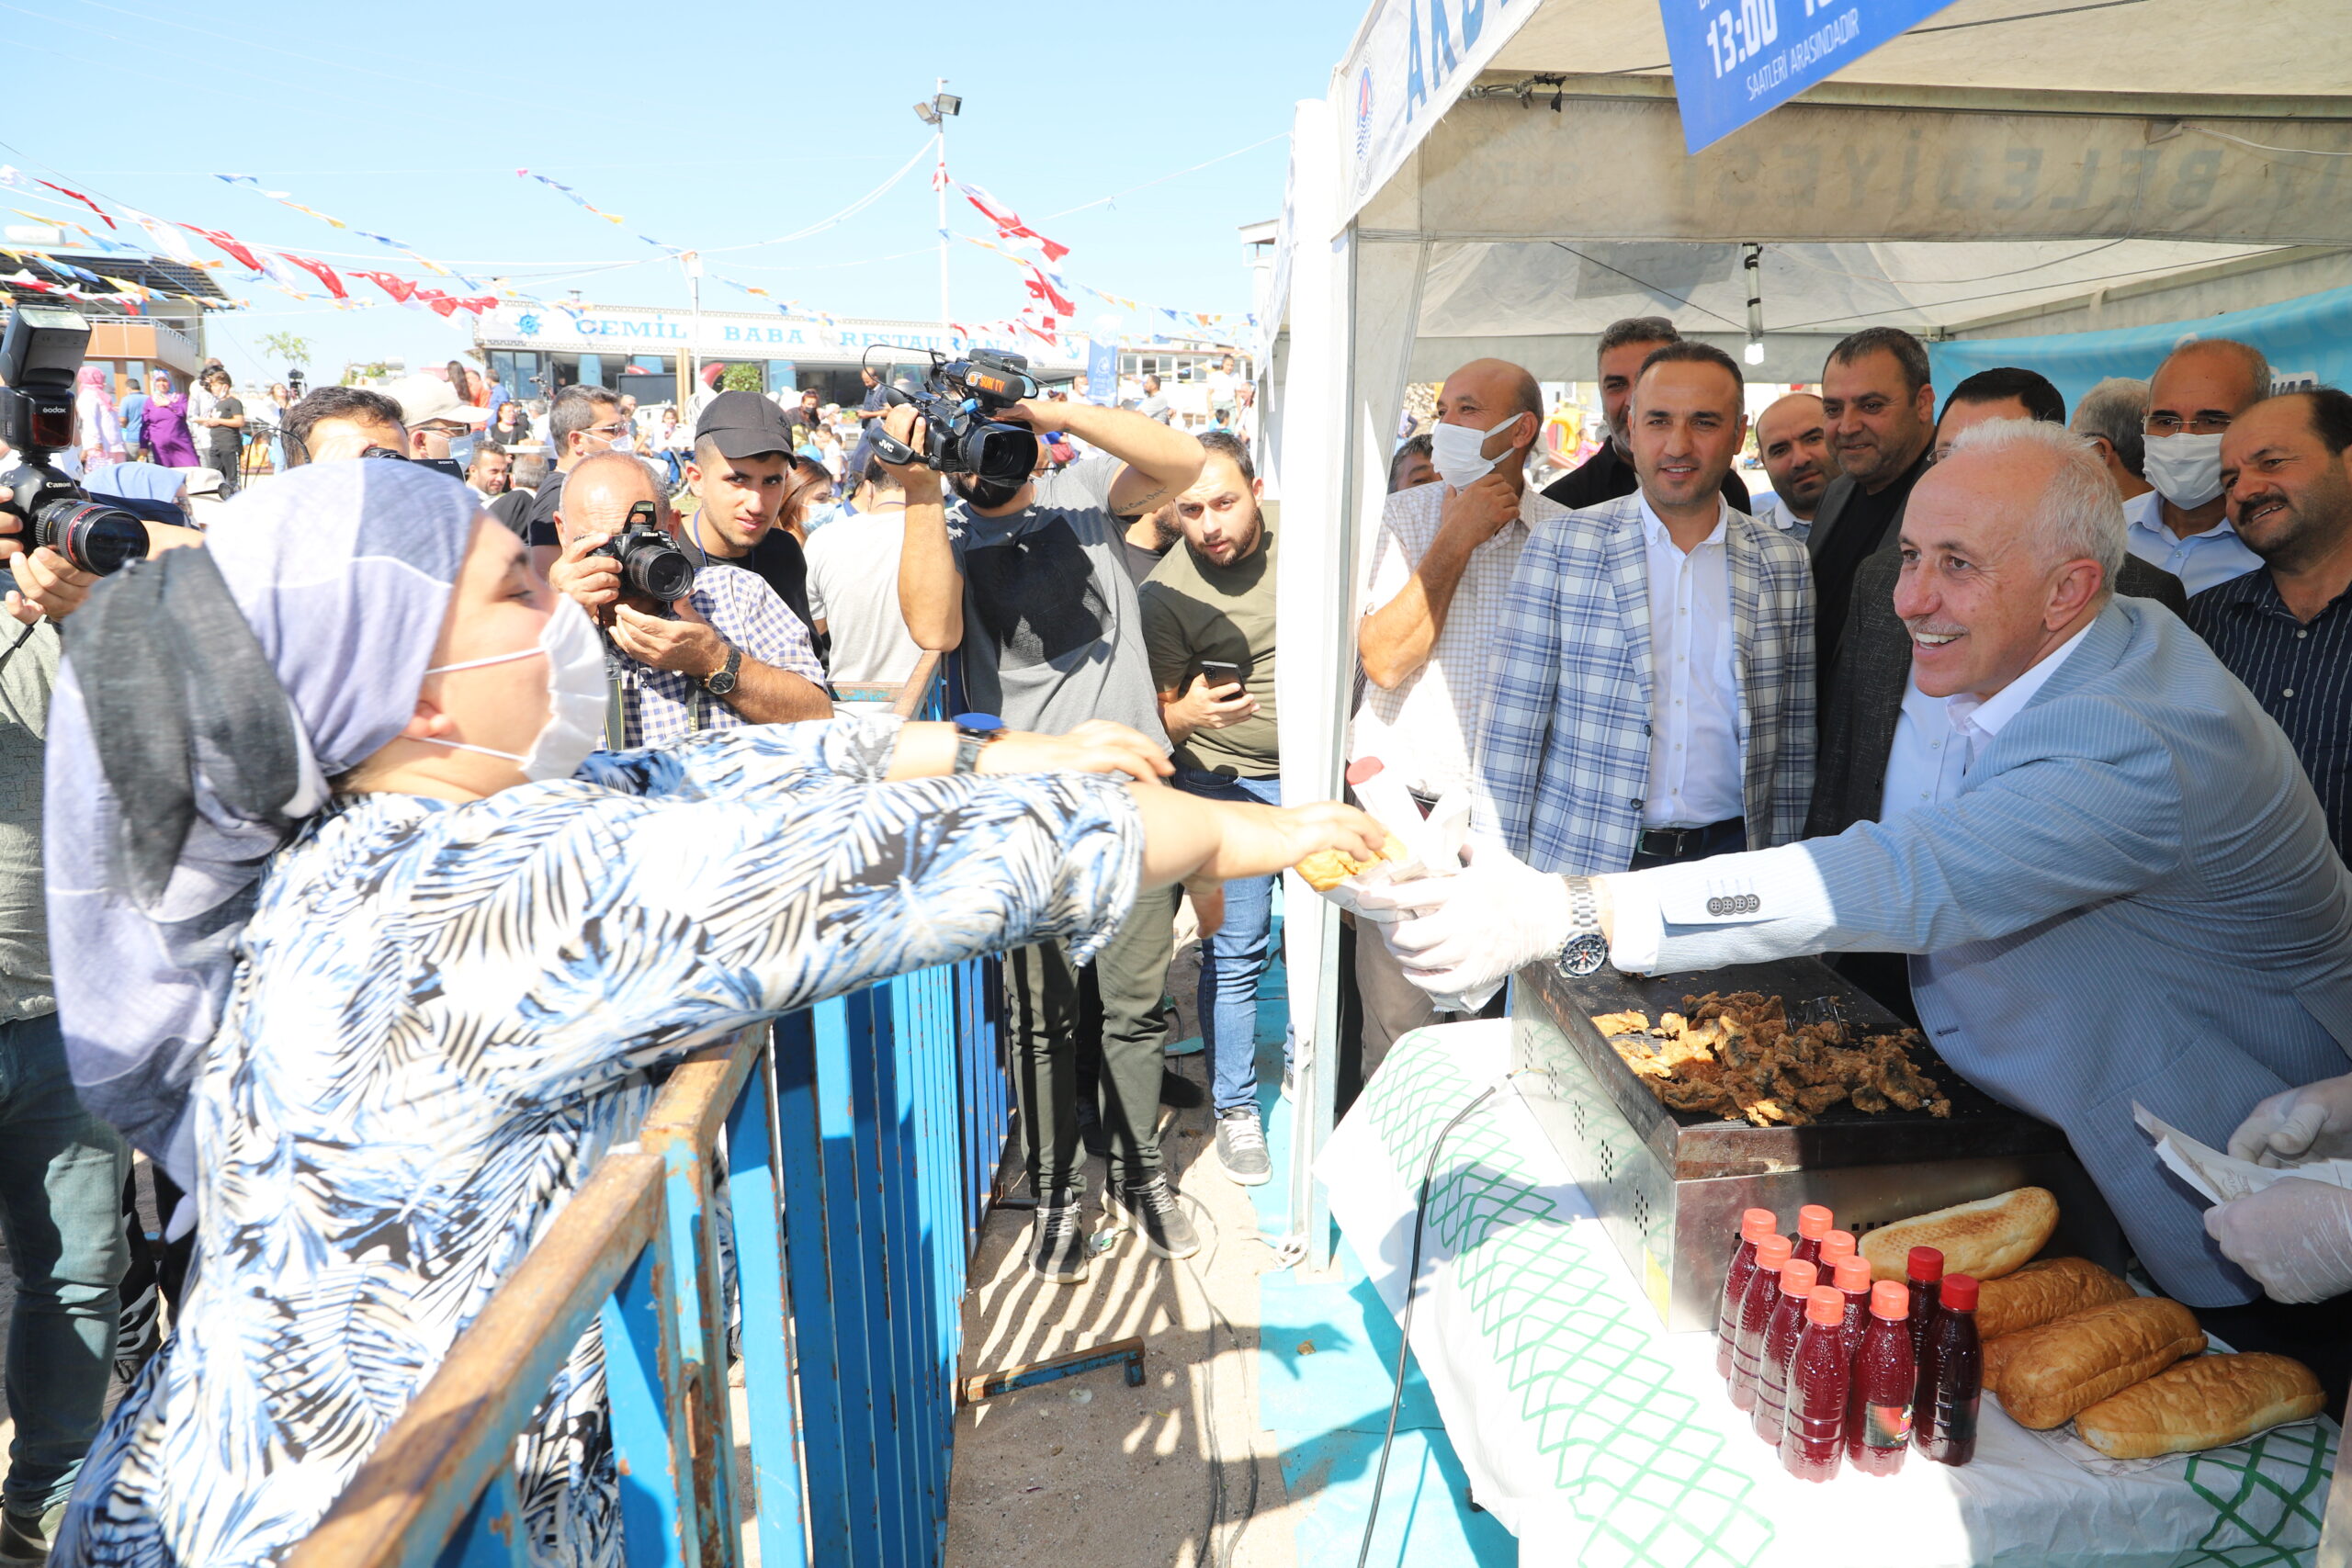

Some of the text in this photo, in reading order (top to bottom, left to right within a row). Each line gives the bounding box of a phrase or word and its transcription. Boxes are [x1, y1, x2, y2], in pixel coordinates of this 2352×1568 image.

[1746, 7, 1860, 102] SAATLERİ ARASINDADIR
[575, 313, 687, 340] CEMİL
[723, 325, 806, 344] BABA
[978, 375, 1006, 393] SUN TV
[878, 438, 895, 454] JVC
[46, 480, 72, 489] Canon
